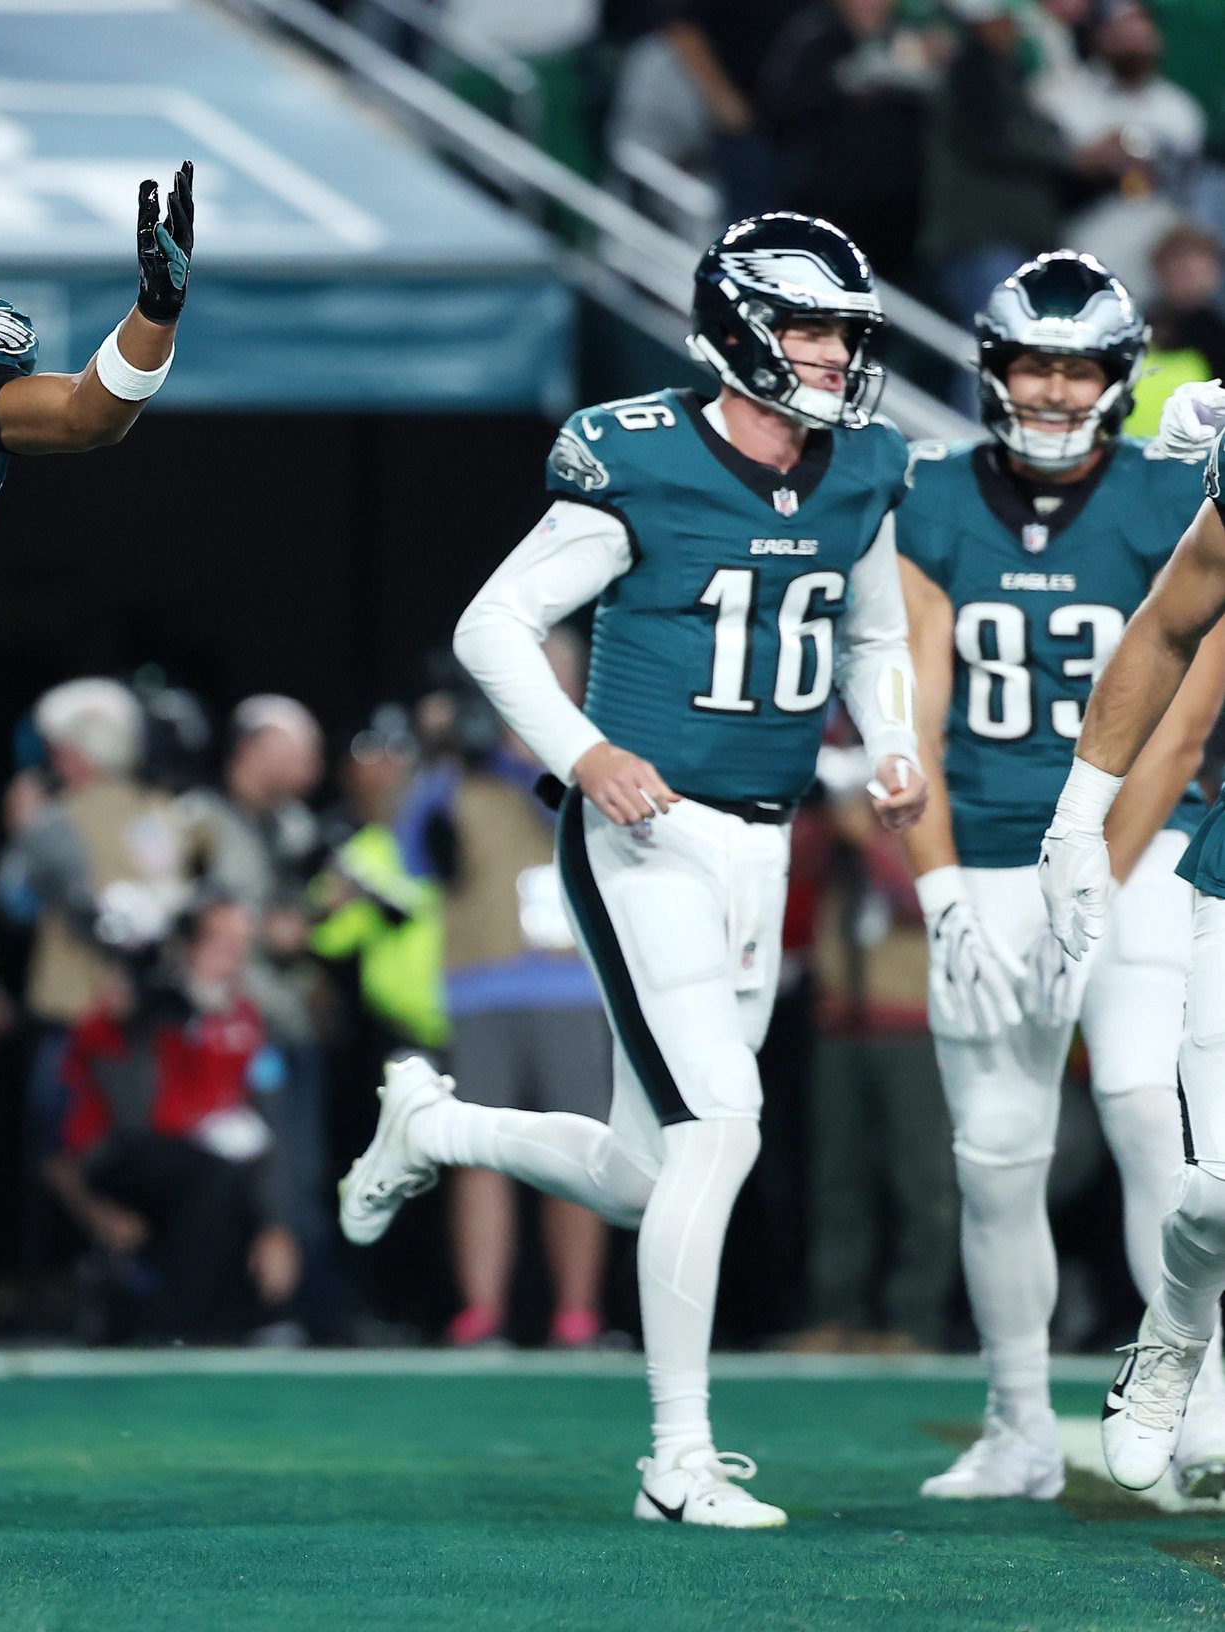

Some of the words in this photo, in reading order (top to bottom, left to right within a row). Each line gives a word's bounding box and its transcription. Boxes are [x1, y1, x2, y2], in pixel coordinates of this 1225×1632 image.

[750, 539, 818, 555] EAGLES
[1000, 573, 1076, 592] EAGLES
[693, 568, 846, 713] 16
[954, 602, 1125, 740] 83
